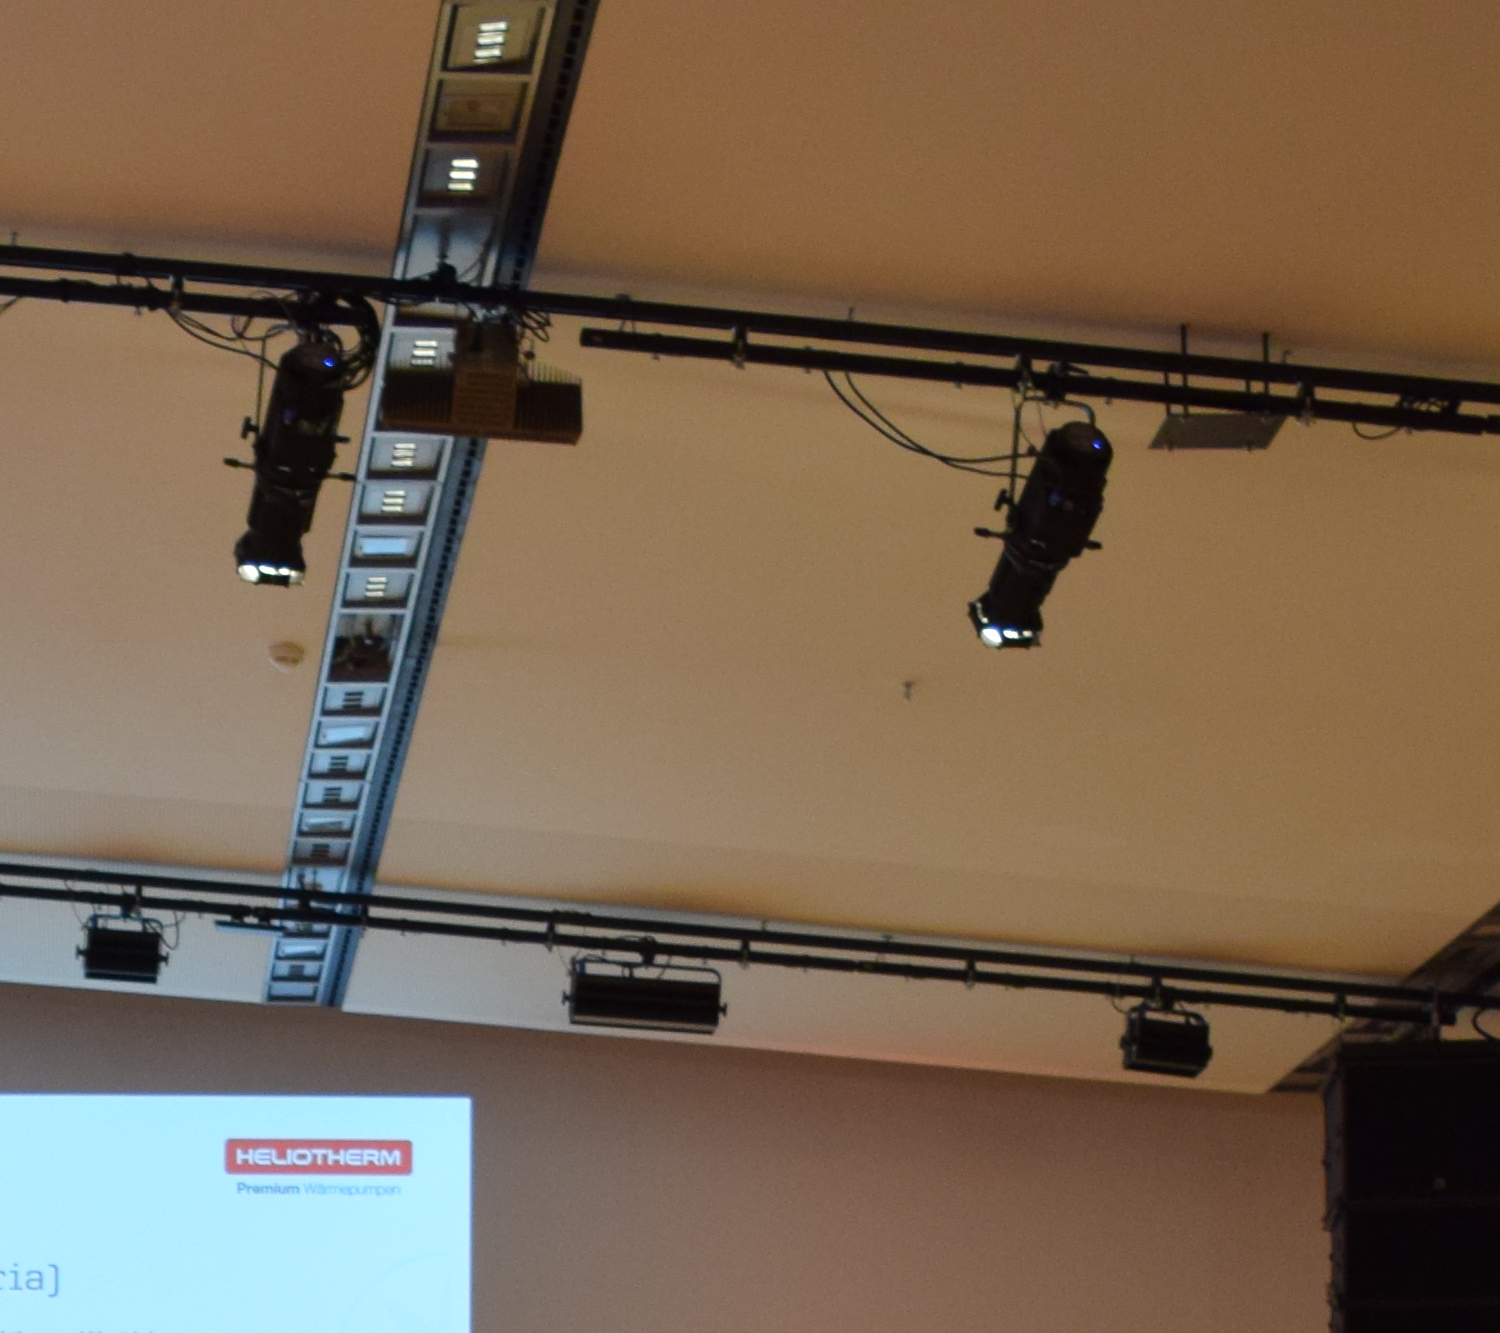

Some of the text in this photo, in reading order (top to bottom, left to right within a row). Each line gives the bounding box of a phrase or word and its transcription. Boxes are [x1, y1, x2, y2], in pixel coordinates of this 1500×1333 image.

[235, 1147, 402, 1166] HELIOTHERM
[236, 1181, 401, 1197] Premium Wärmepumpen
